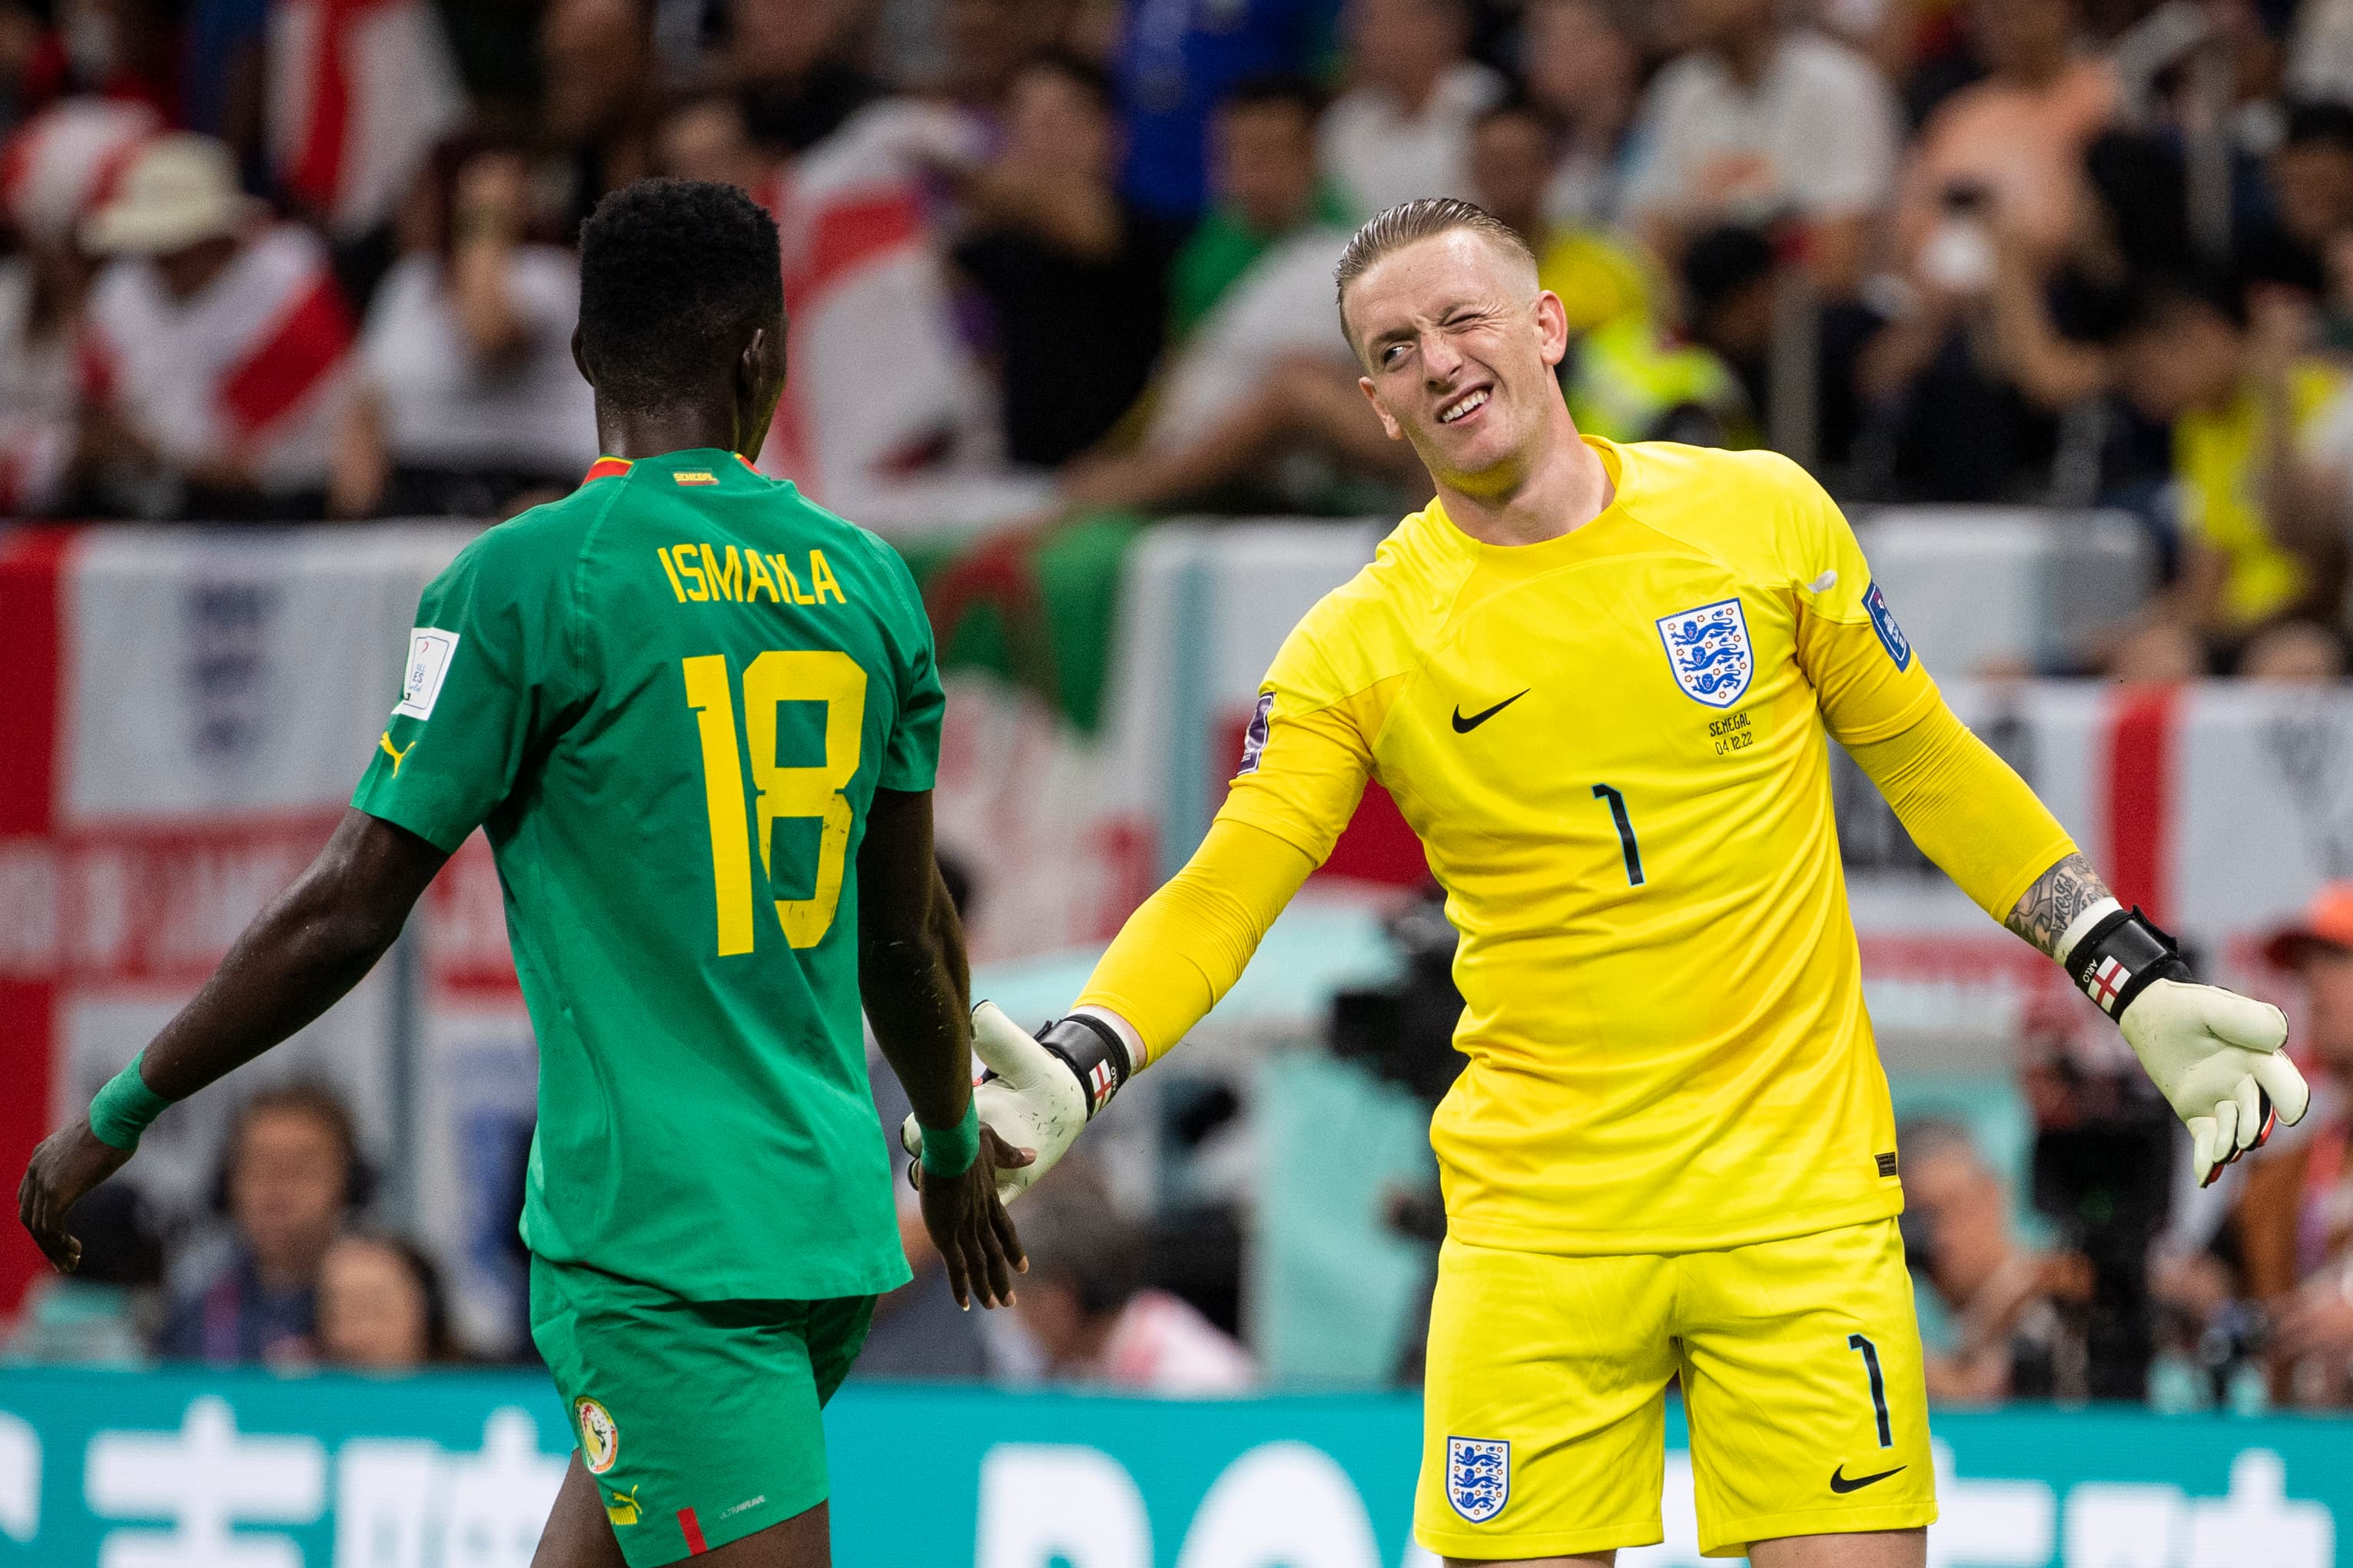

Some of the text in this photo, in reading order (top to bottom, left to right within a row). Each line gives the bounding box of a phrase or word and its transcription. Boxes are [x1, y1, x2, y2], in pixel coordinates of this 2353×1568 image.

[1708, 712, 1751, 738] SENEGAL
[1714, 731, 1754, 755] 04.12.22
[682, 650, 868, 957] 18
[1591, 782, 1646, 887] 1
[2082, 958, 2098, 983] ARLO
[1847, 1332, 1893, 1449] 1
